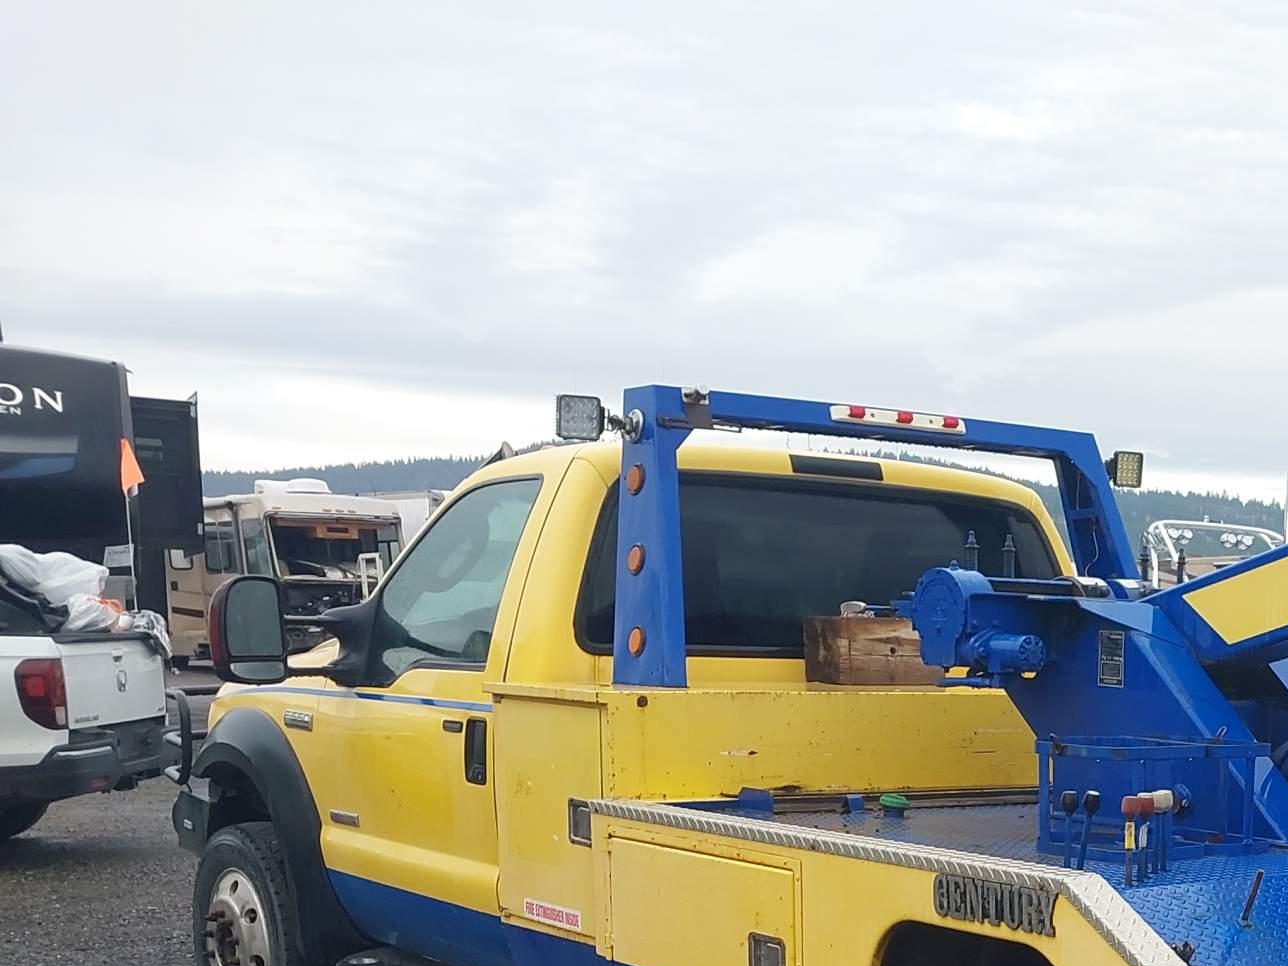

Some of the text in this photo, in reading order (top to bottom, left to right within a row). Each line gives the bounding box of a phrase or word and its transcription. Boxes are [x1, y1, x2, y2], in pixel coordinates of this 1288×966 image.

[526, 901, 535, 917] FIRE
[565, 912, 580, 928] INSIDE
[933, 874, 1059, 938] CENTURY
